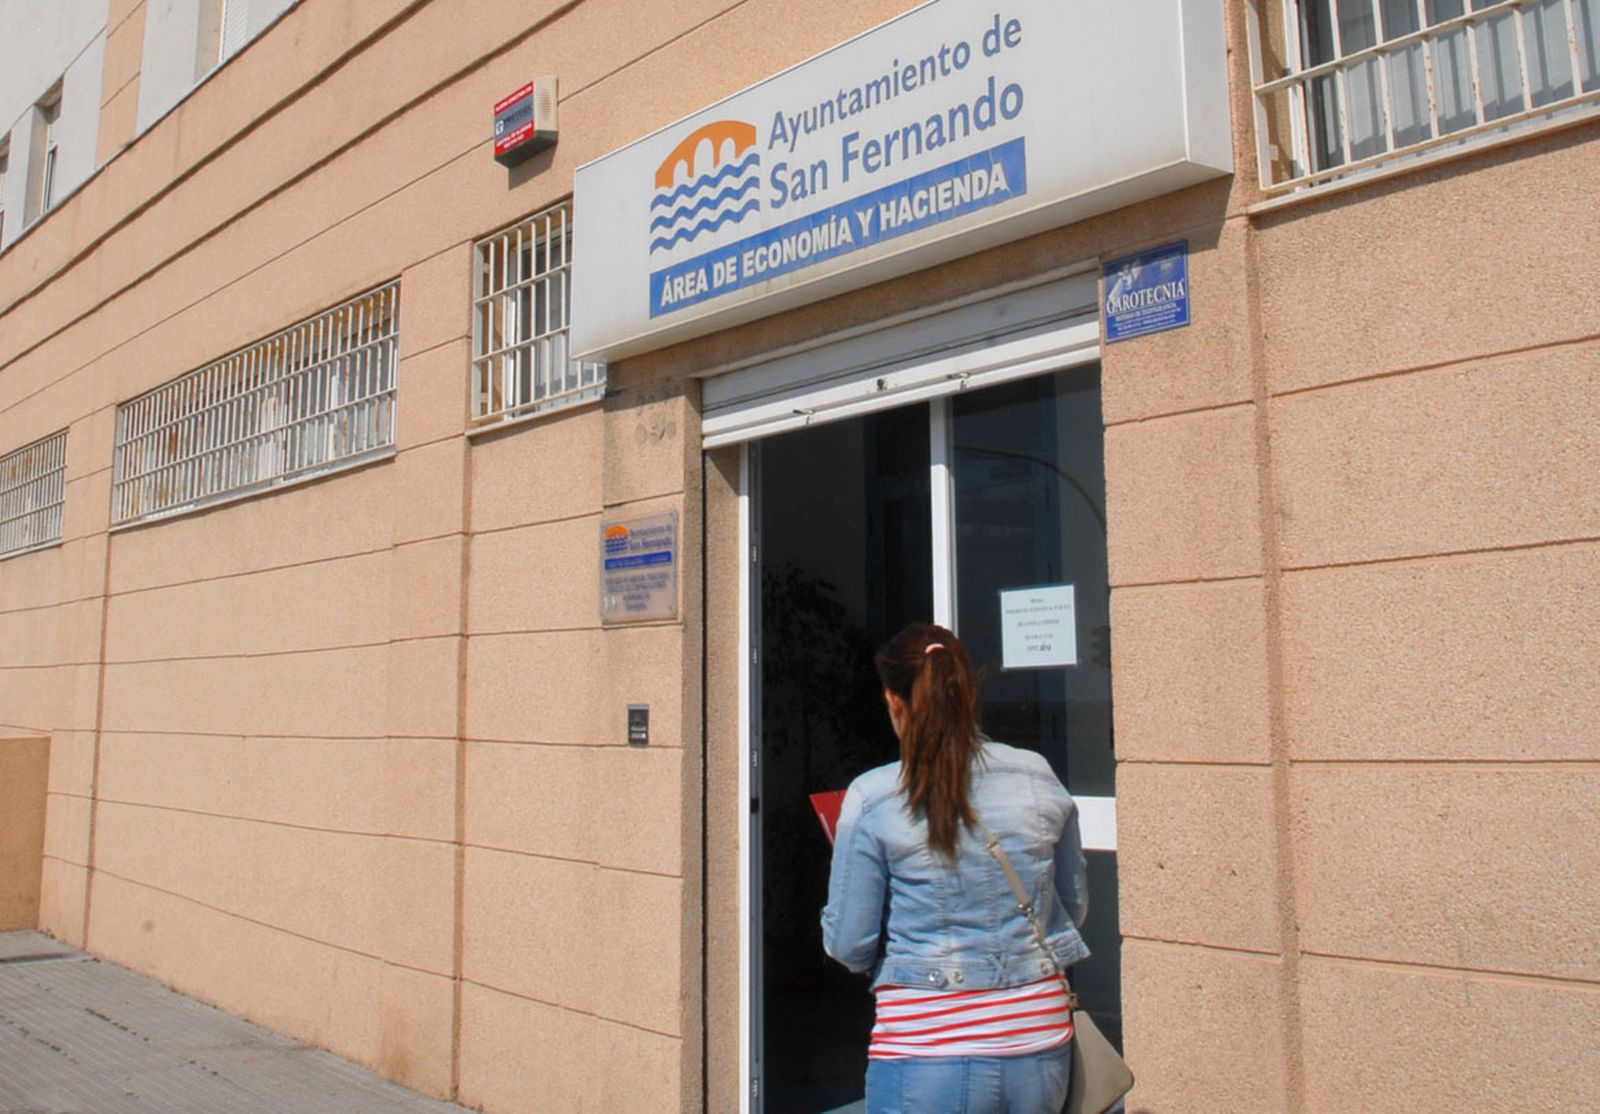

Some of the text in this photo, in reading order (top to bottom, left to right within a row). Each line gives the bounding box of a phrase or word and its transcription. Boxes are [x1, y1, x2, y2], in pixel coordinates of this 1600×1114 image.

[767, 13, 1022, 153] Ayuntamiento de
[769, 75, 1024, 209] San Fernando
[660, 163, 1010, 307] ÁREA DE ECONOMÍA Y HACIENDA
